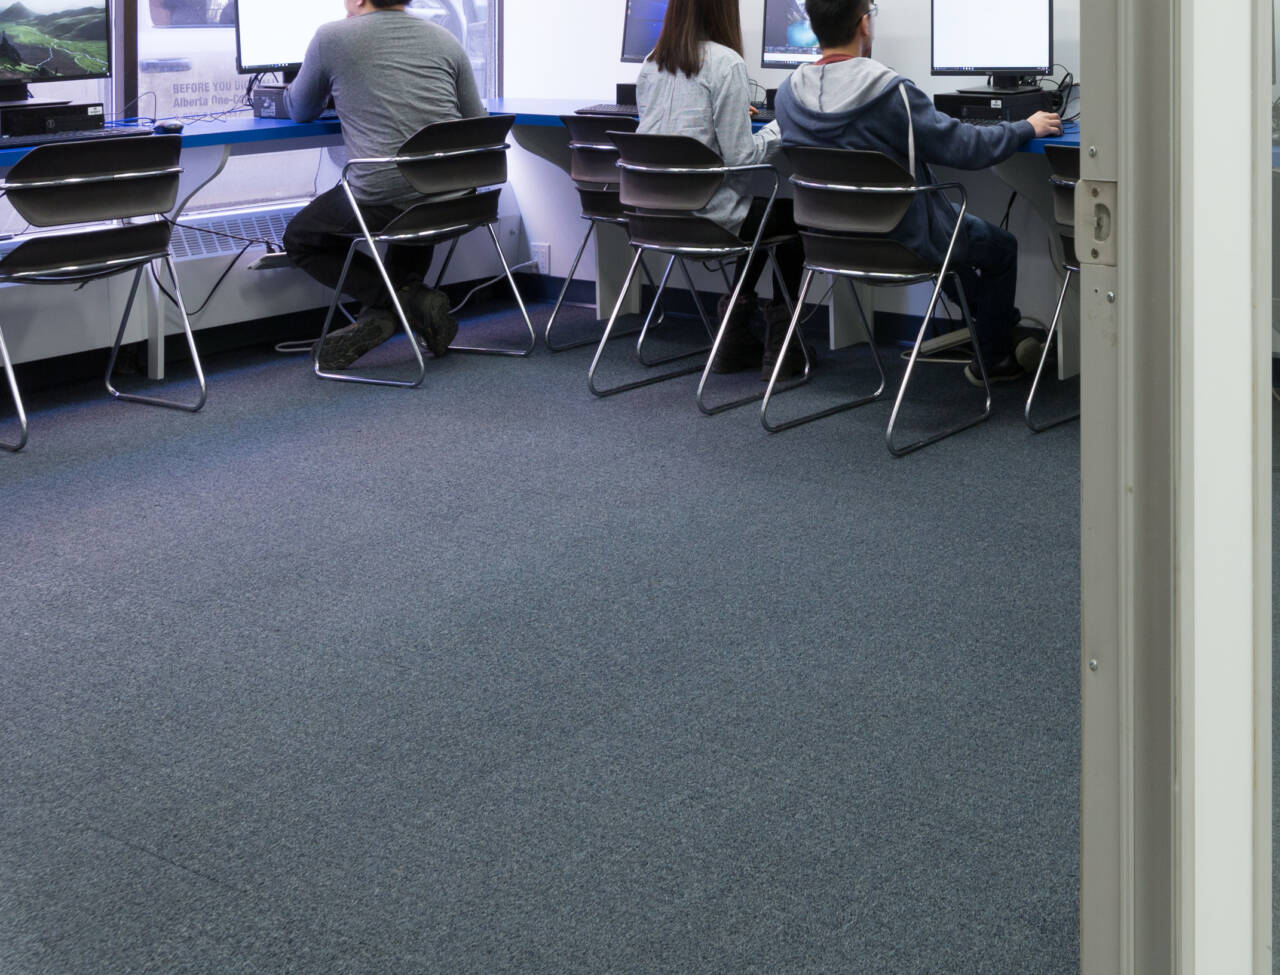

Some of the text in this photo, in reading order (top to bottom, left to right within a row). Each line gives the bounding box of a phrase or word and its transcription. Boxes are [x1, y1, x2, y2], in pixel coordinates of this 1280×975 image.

[173, 82, 210, 94] BEFORE
[212, 80, 232, 92] YOU
[173, 95, 208, 108] Alberta
